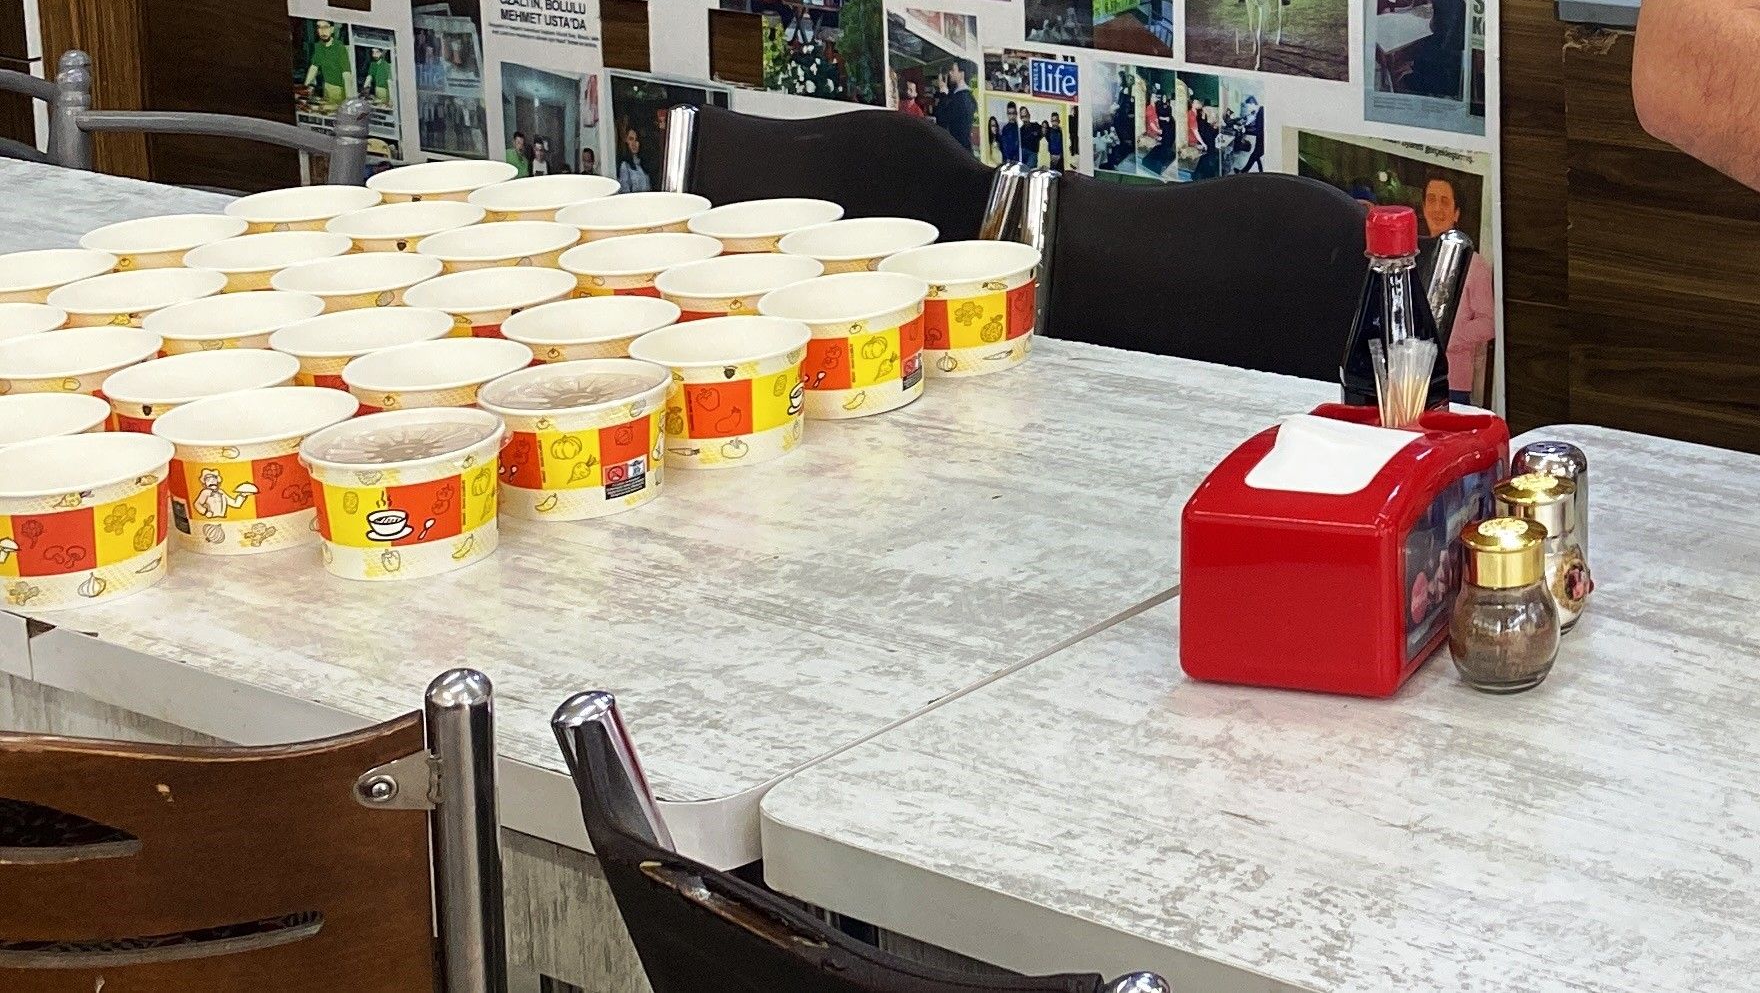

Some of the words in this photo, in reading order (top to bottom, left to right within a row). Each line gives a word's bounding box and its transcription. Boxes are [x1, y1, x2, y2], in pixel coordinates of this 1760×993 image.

[544, 0, 586, 15] BOLULU
[500, 9, 542, 24] MEHMET
[544, 15, 586, 31] USTA'DA
[1040, 62, 1077, 96] life
